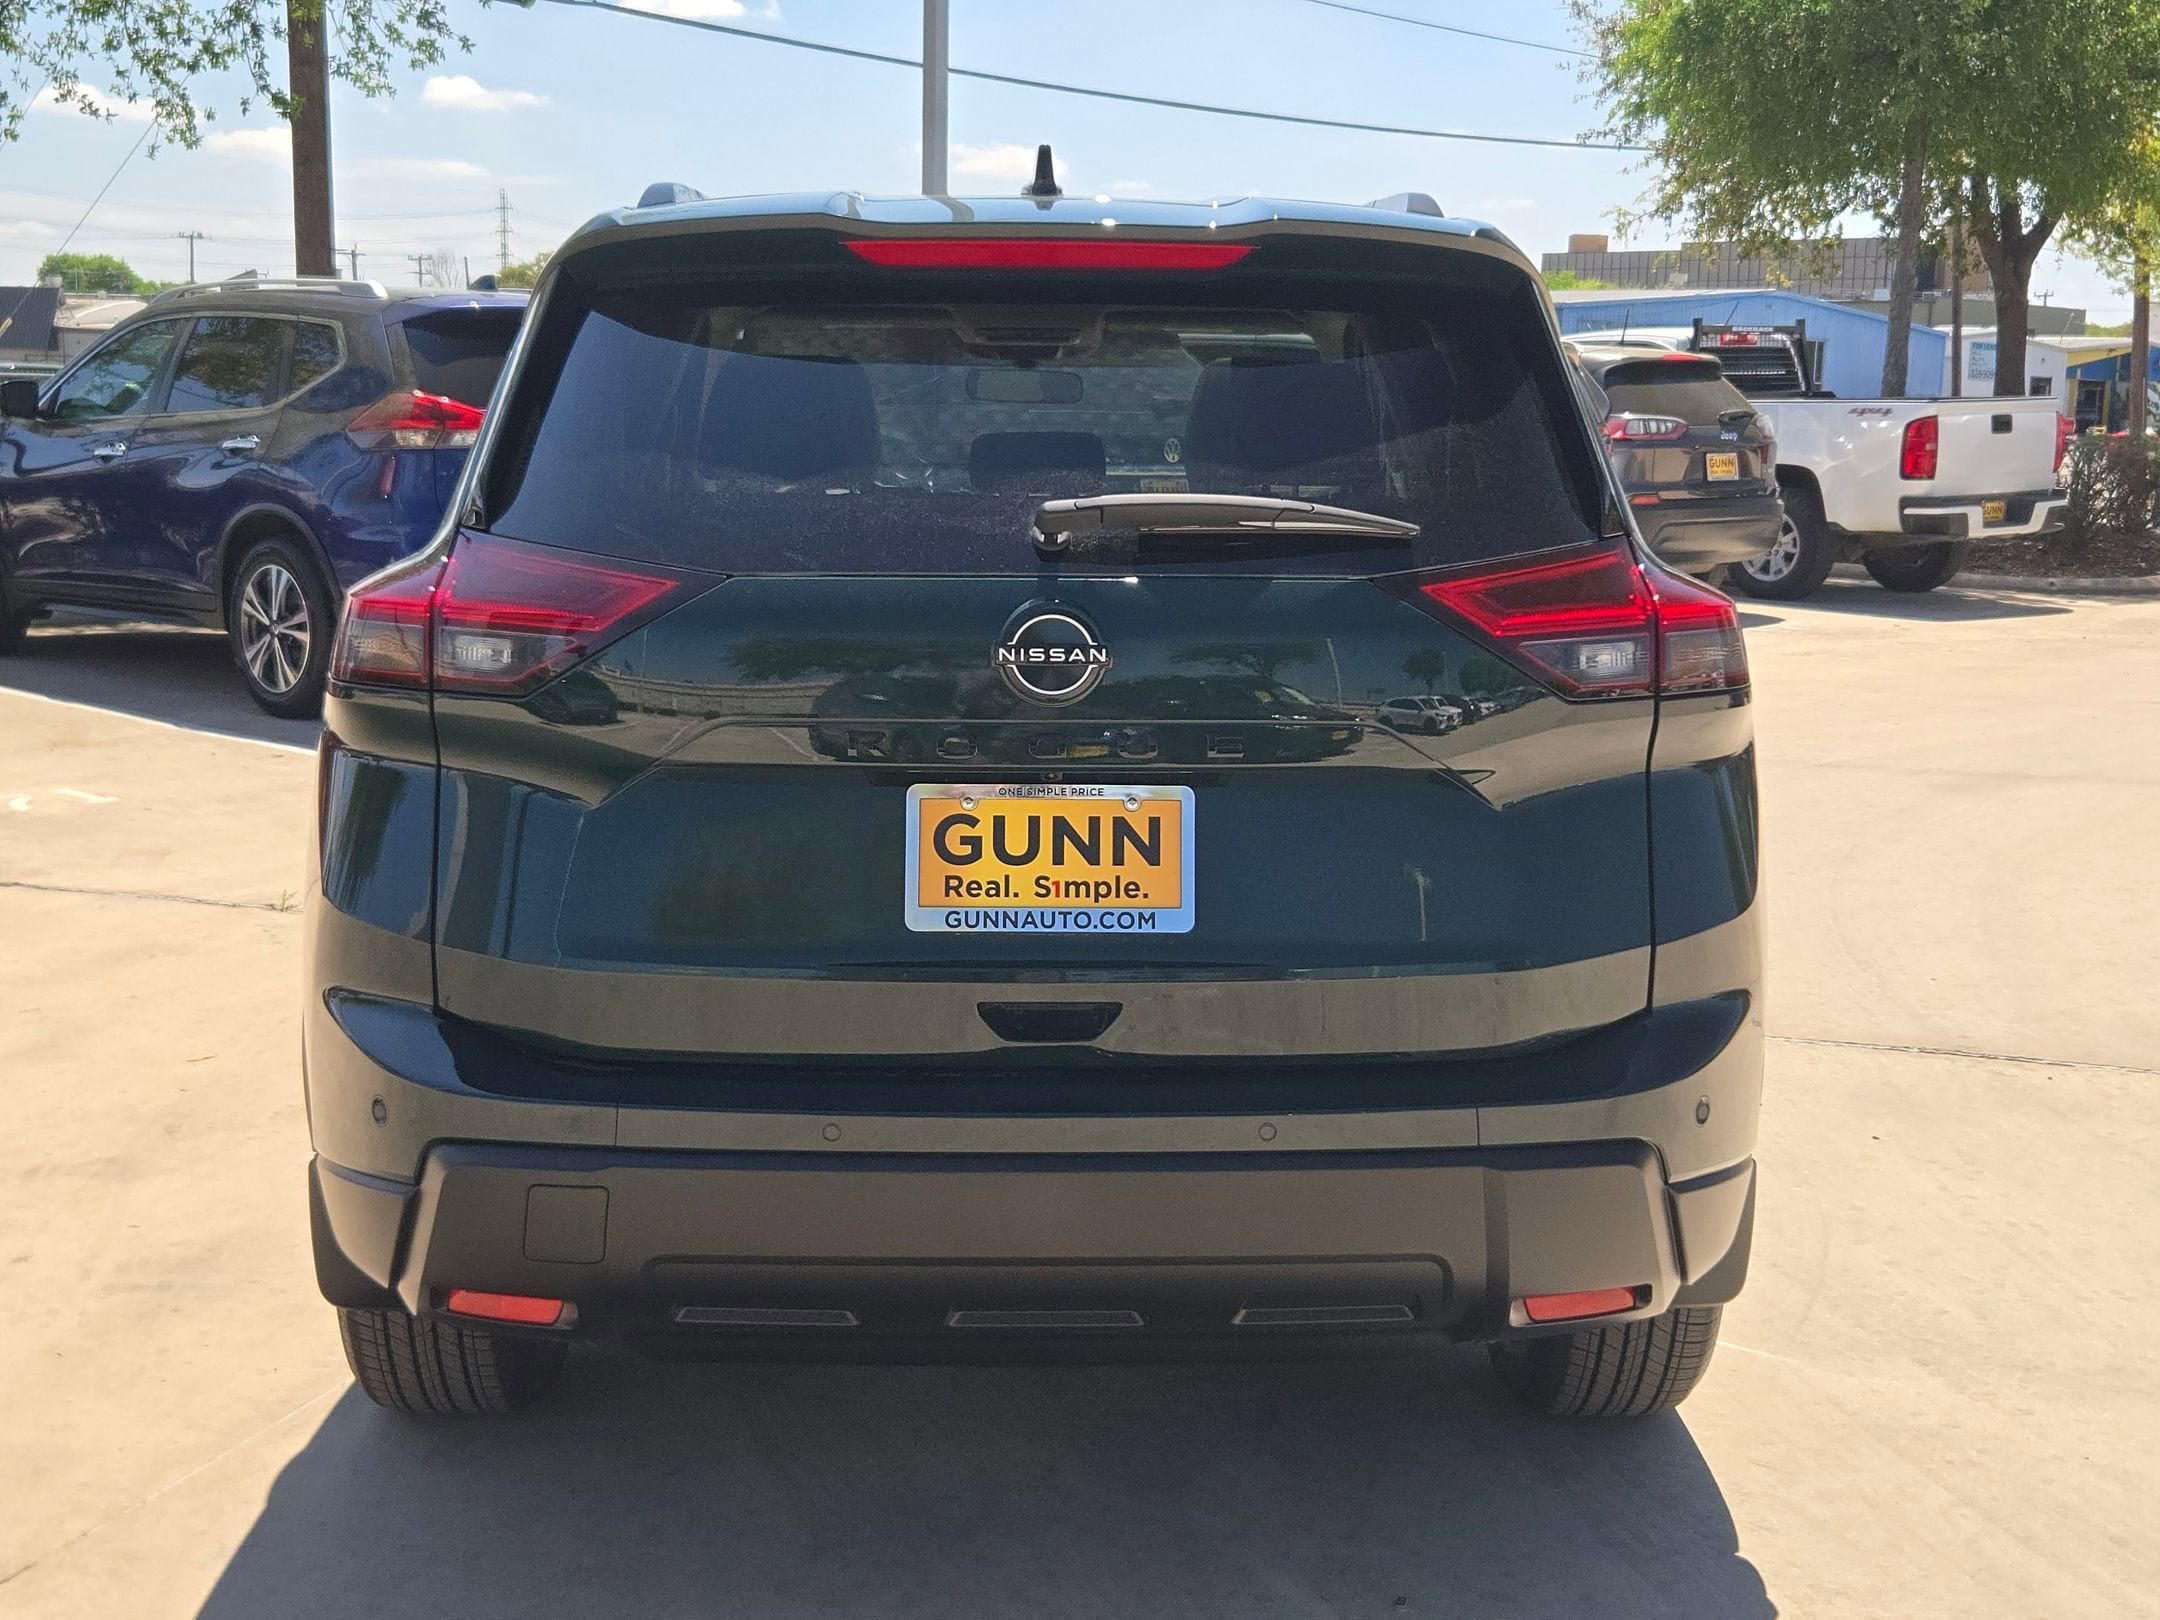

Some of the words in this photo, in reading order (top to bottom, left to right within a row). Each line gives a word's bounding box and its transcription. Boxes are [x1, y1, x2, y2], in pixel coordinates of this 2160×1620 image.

[1721, 431, 1738, 442] Jeep
[1710, 457, 1734, 469] GUNN
[998, 647, 1107, 663] NISSAN
[846, 730, 1245, 759] ROGUE
[998, 786, 1023, 797] ONE
[1026, 786, 1068, 797] SIMPLE
[1071, 787, 1105, 798] PRICE
[933, 813, 1162, 867] GUNN
[944, 874, 1020, 899] Real.
[1033, 875, 1150, 904] S1mple.
[944, 910, 1157, 931] GUNNAUTO.COM
